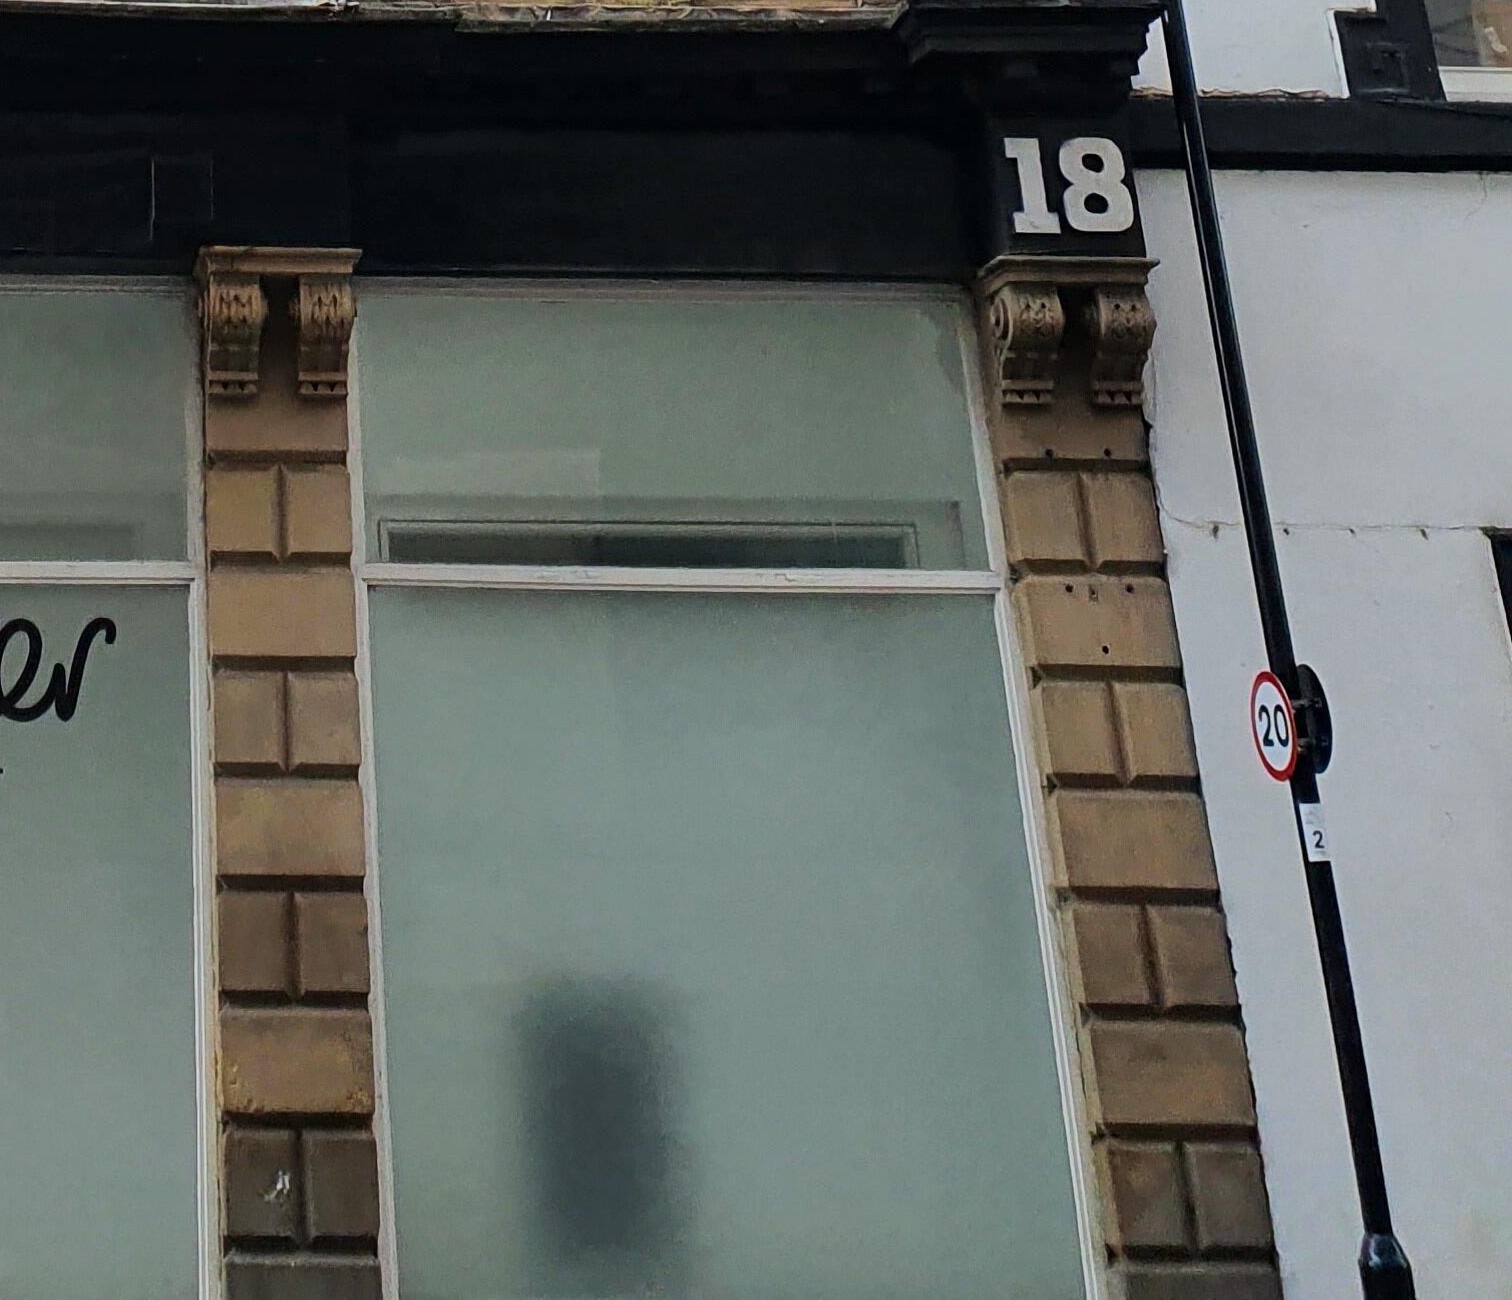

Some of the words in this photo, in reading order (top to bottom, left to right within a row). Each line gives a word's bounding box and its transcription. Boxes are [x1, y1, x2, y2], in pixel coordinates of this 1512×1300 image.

[1004, 137, 1134, 234] 18
[1258, 704, 1289, 748] 20
[1312, 830, 1325, 849] 2
